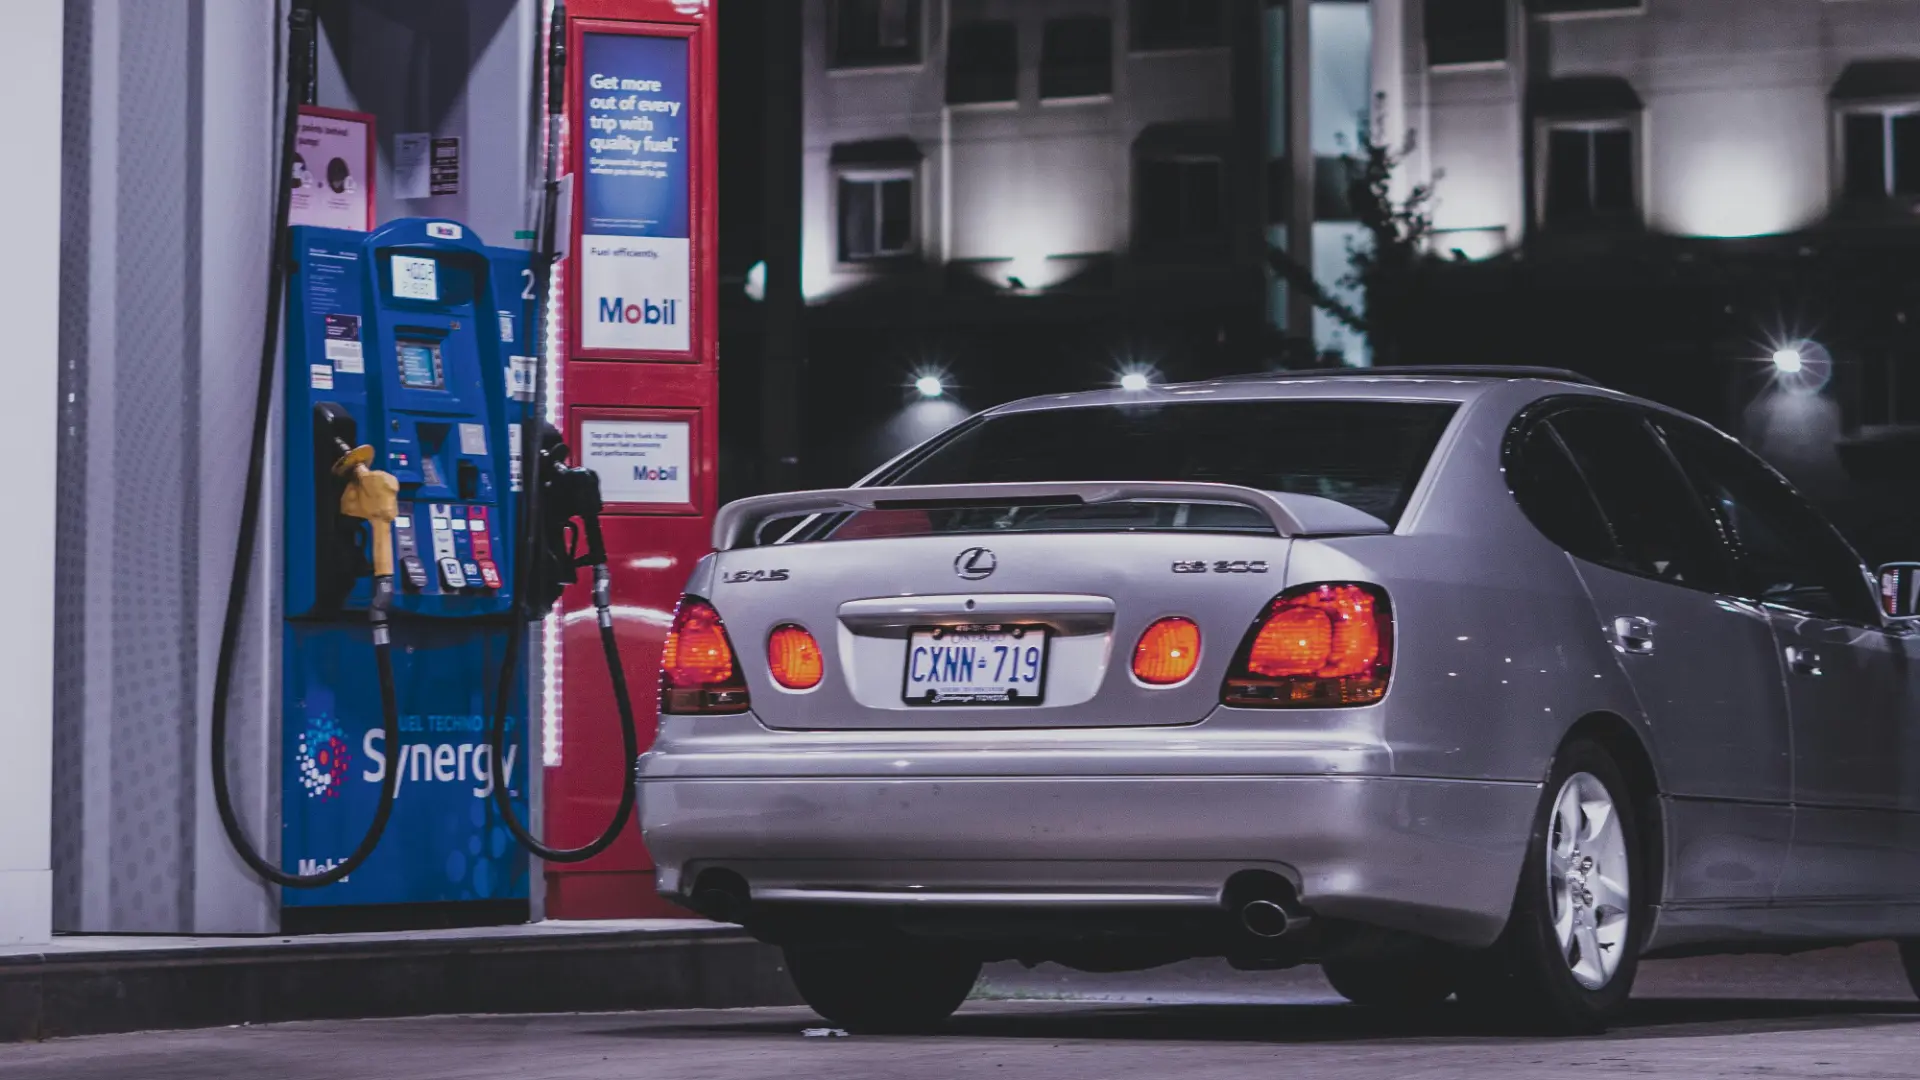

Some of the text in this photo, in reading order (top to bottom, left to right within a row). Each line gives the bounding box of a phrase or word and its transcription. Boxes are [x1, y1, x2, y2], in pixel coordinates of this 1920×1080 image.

[589, 73, 662, 92] Get more
[589, 95, 681, 117] out of every
[589, 114, 654, 134] trip with
[589, 135, 641, 155] quality
[590, 247, 610, 256] Fuel
[521, 269, 536, 299] 2
[599, 297, 676, 325] Mobil
[633, 466, 678, 481] Mobil
[398, 715, 424, 731] UEL
